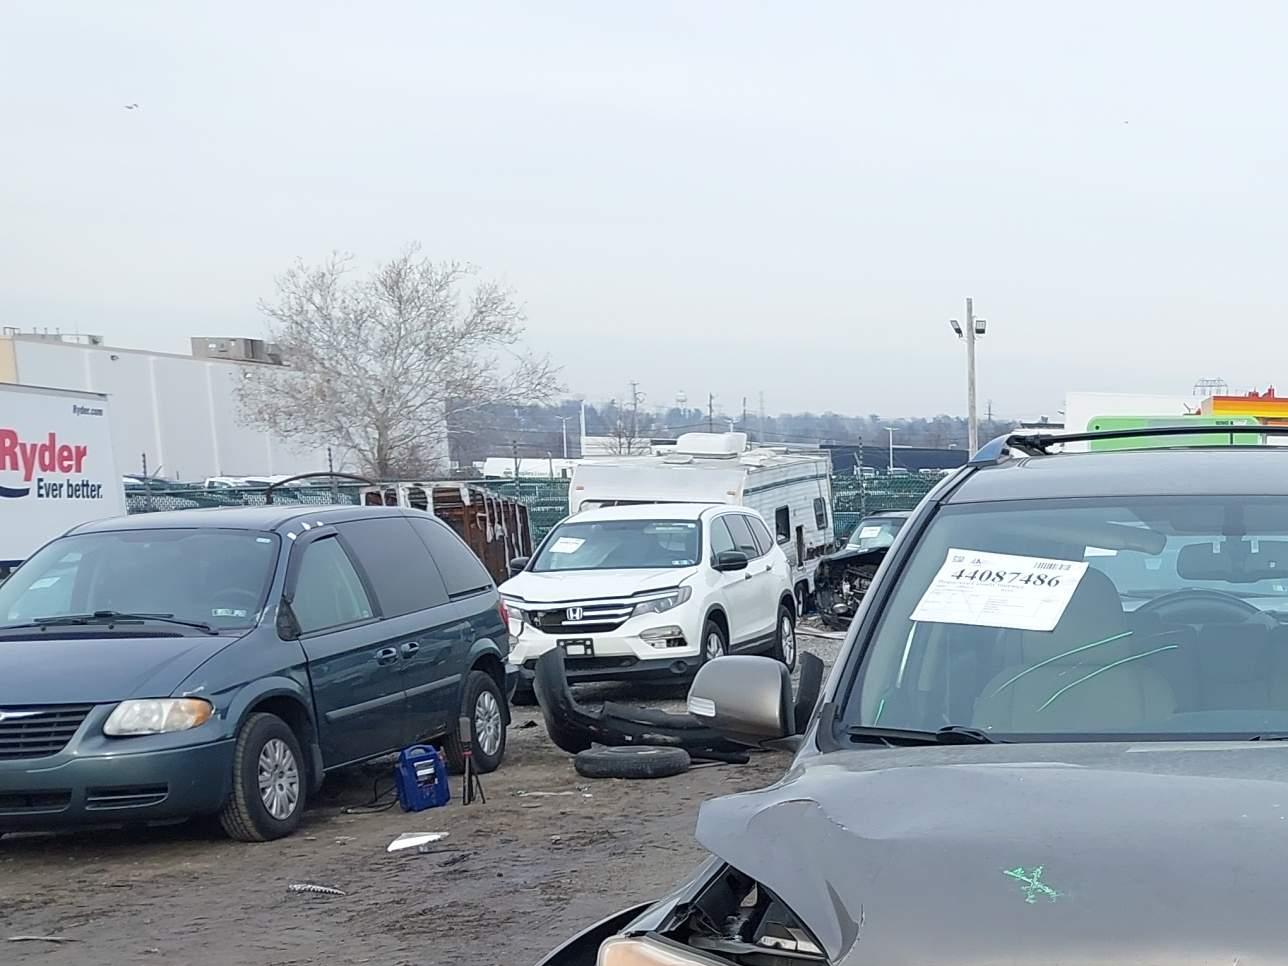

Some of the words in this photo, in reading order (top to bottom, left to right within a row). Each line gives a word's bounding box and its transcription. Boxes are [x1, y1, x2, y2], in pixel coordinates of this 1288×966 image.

[0, 428, 87, 482] Ryder
[36, 477, 63, 498] Ever
[66, 479, 103, 499] better.
[951, 568, 1062, 588] 44087486
